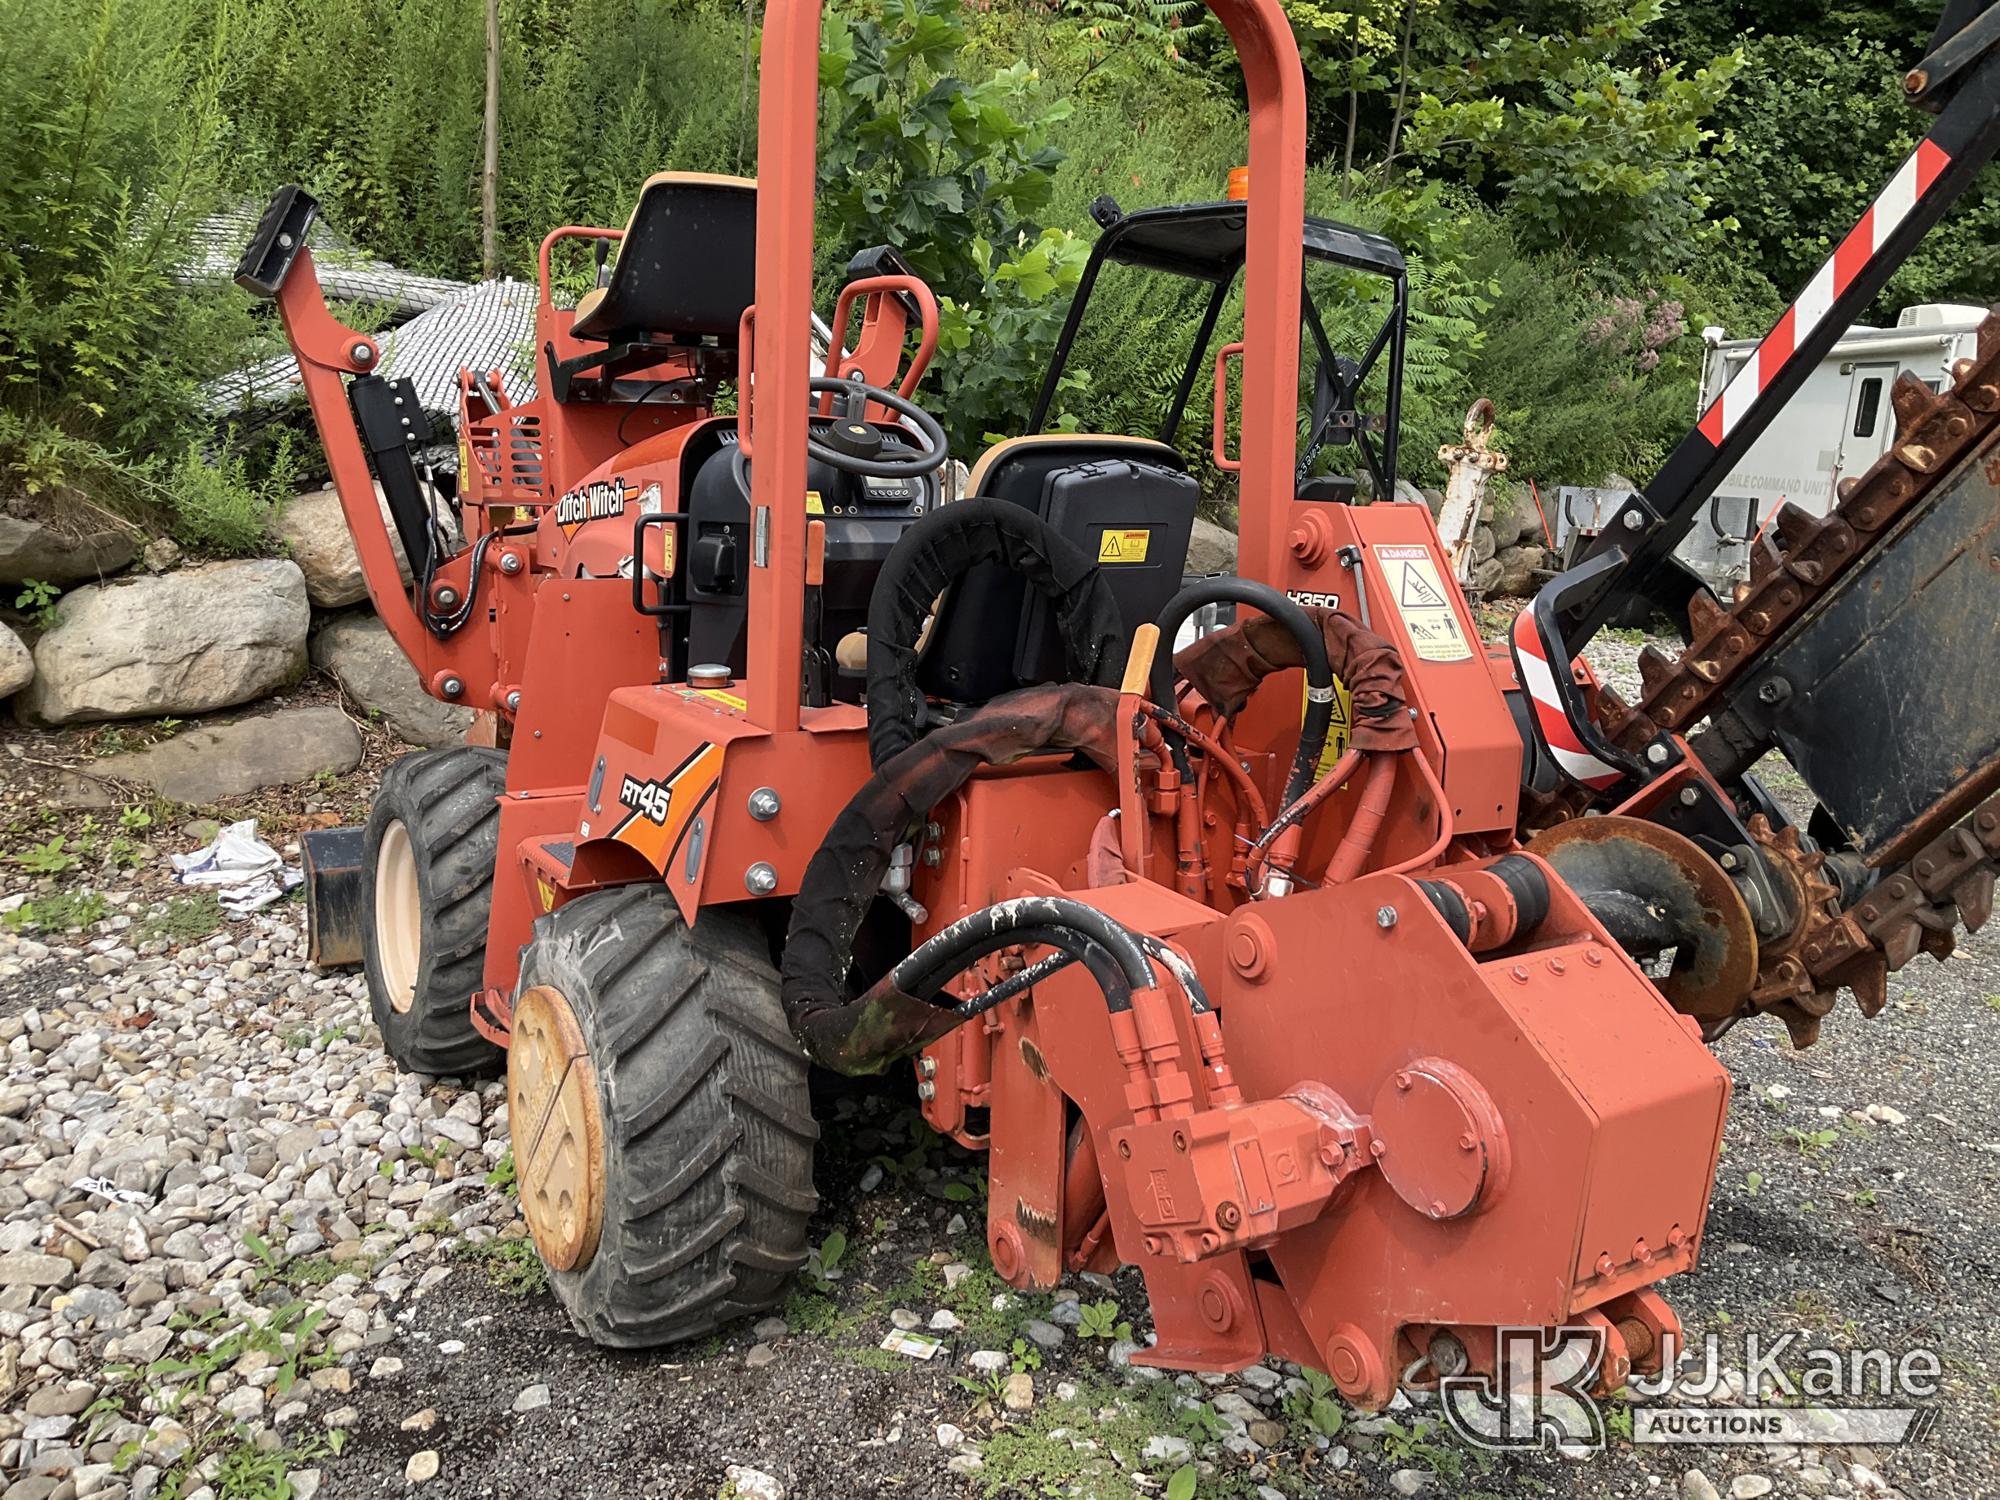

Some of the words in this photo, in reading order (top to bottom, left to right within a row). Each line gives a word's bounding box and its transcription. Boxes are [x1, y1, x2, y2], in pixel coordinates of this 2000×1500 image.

[1723, 473, 1751, 489] BILE
[1751, 475, 1801, 493] COMMAND
[1803, 479, 1831, 496] UNIT
[557, 489, 587, 523] Ditch
[589, 481, 624, 517] Witch
[1391, 549, 1426, 559] DANGER
[620, 778, 671, 823] RT45
